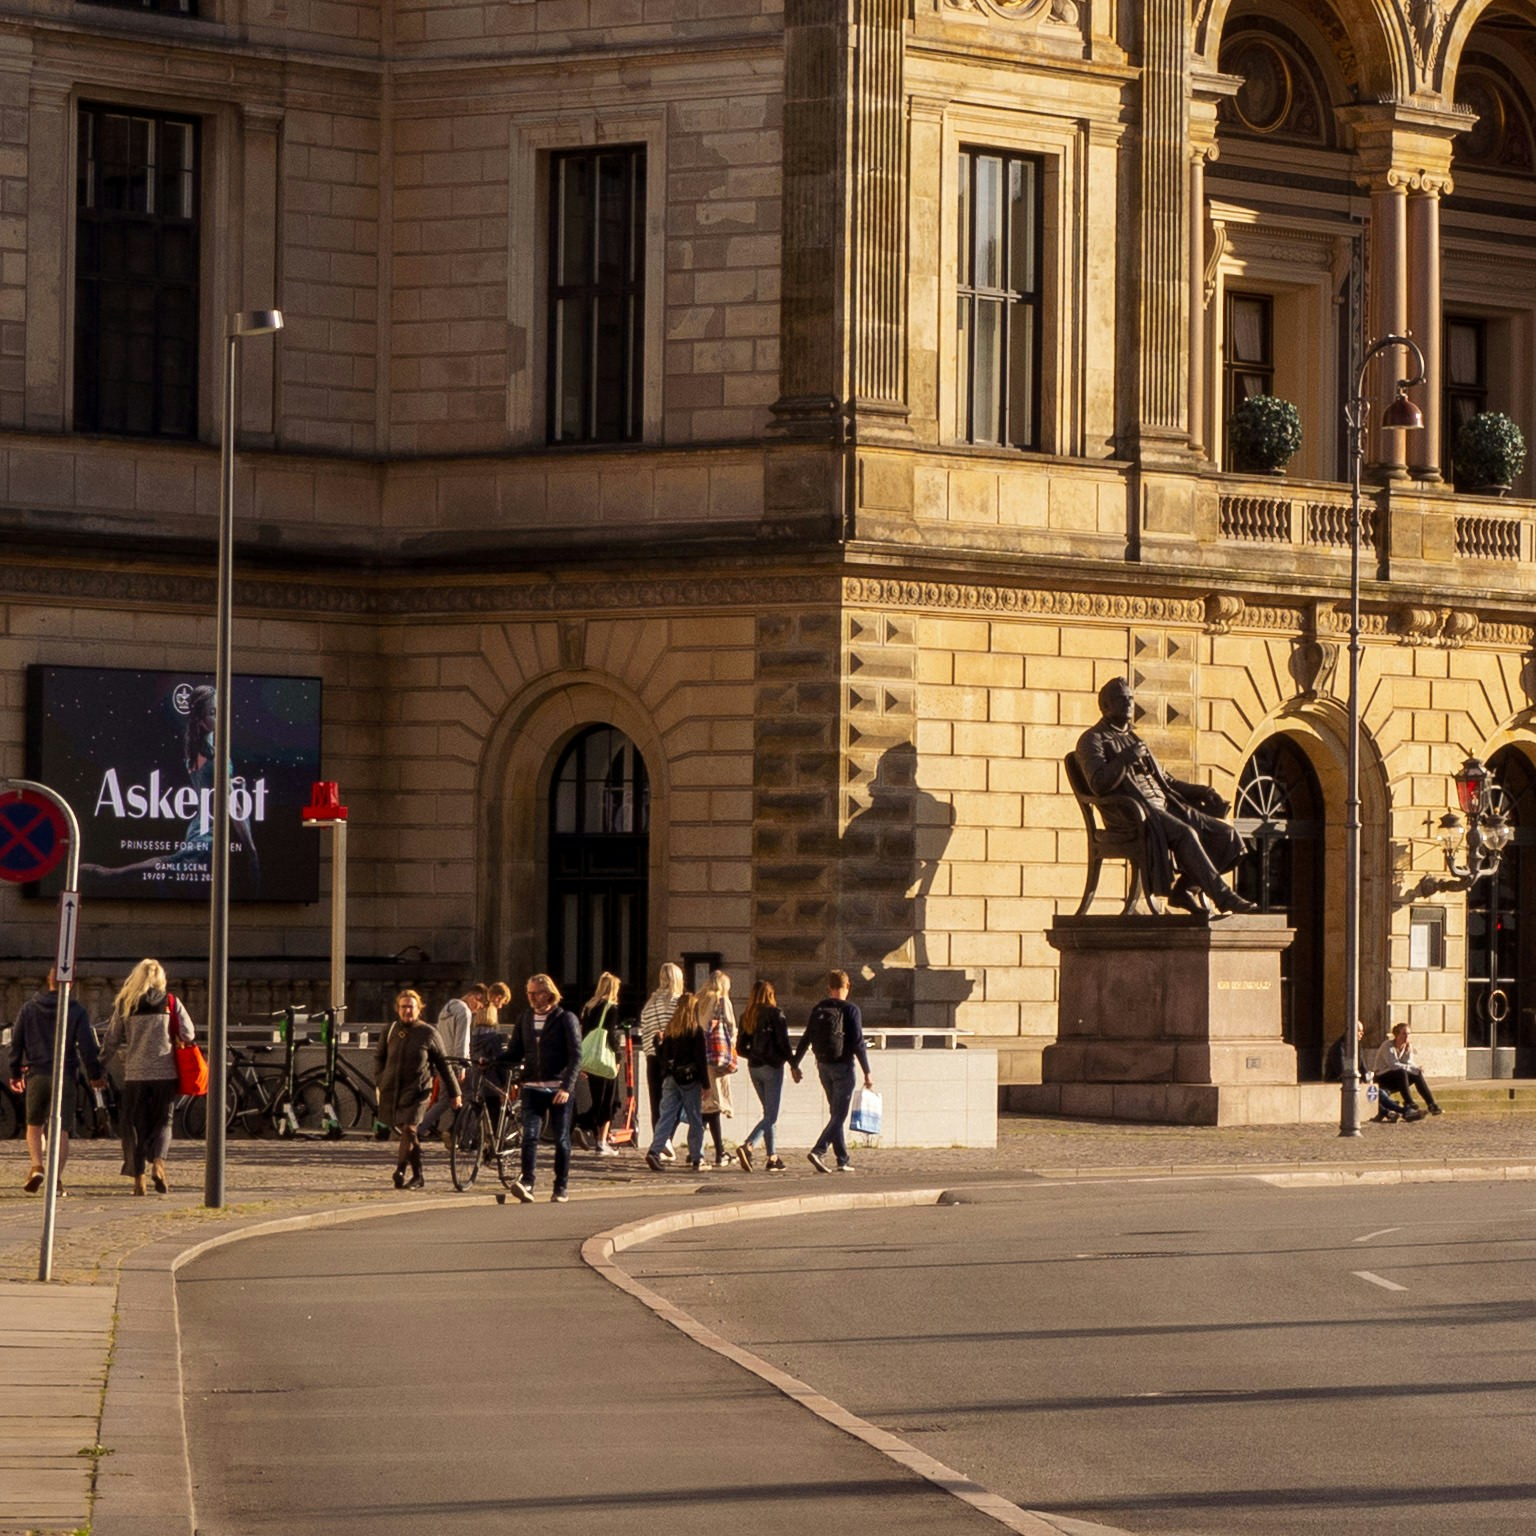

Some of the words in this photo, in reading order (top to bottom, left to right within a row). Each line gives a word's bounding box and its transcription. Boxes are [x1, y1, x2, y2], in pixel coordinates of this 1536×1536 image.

[94, 767, 270, 837] Askepot
[120, 839, 172, 852] PRINSESSE
[174, 840, 194, 852] FOR
[154, 862, 181, 872] GAMLE
[182, 862, 209, 872] SCENE
